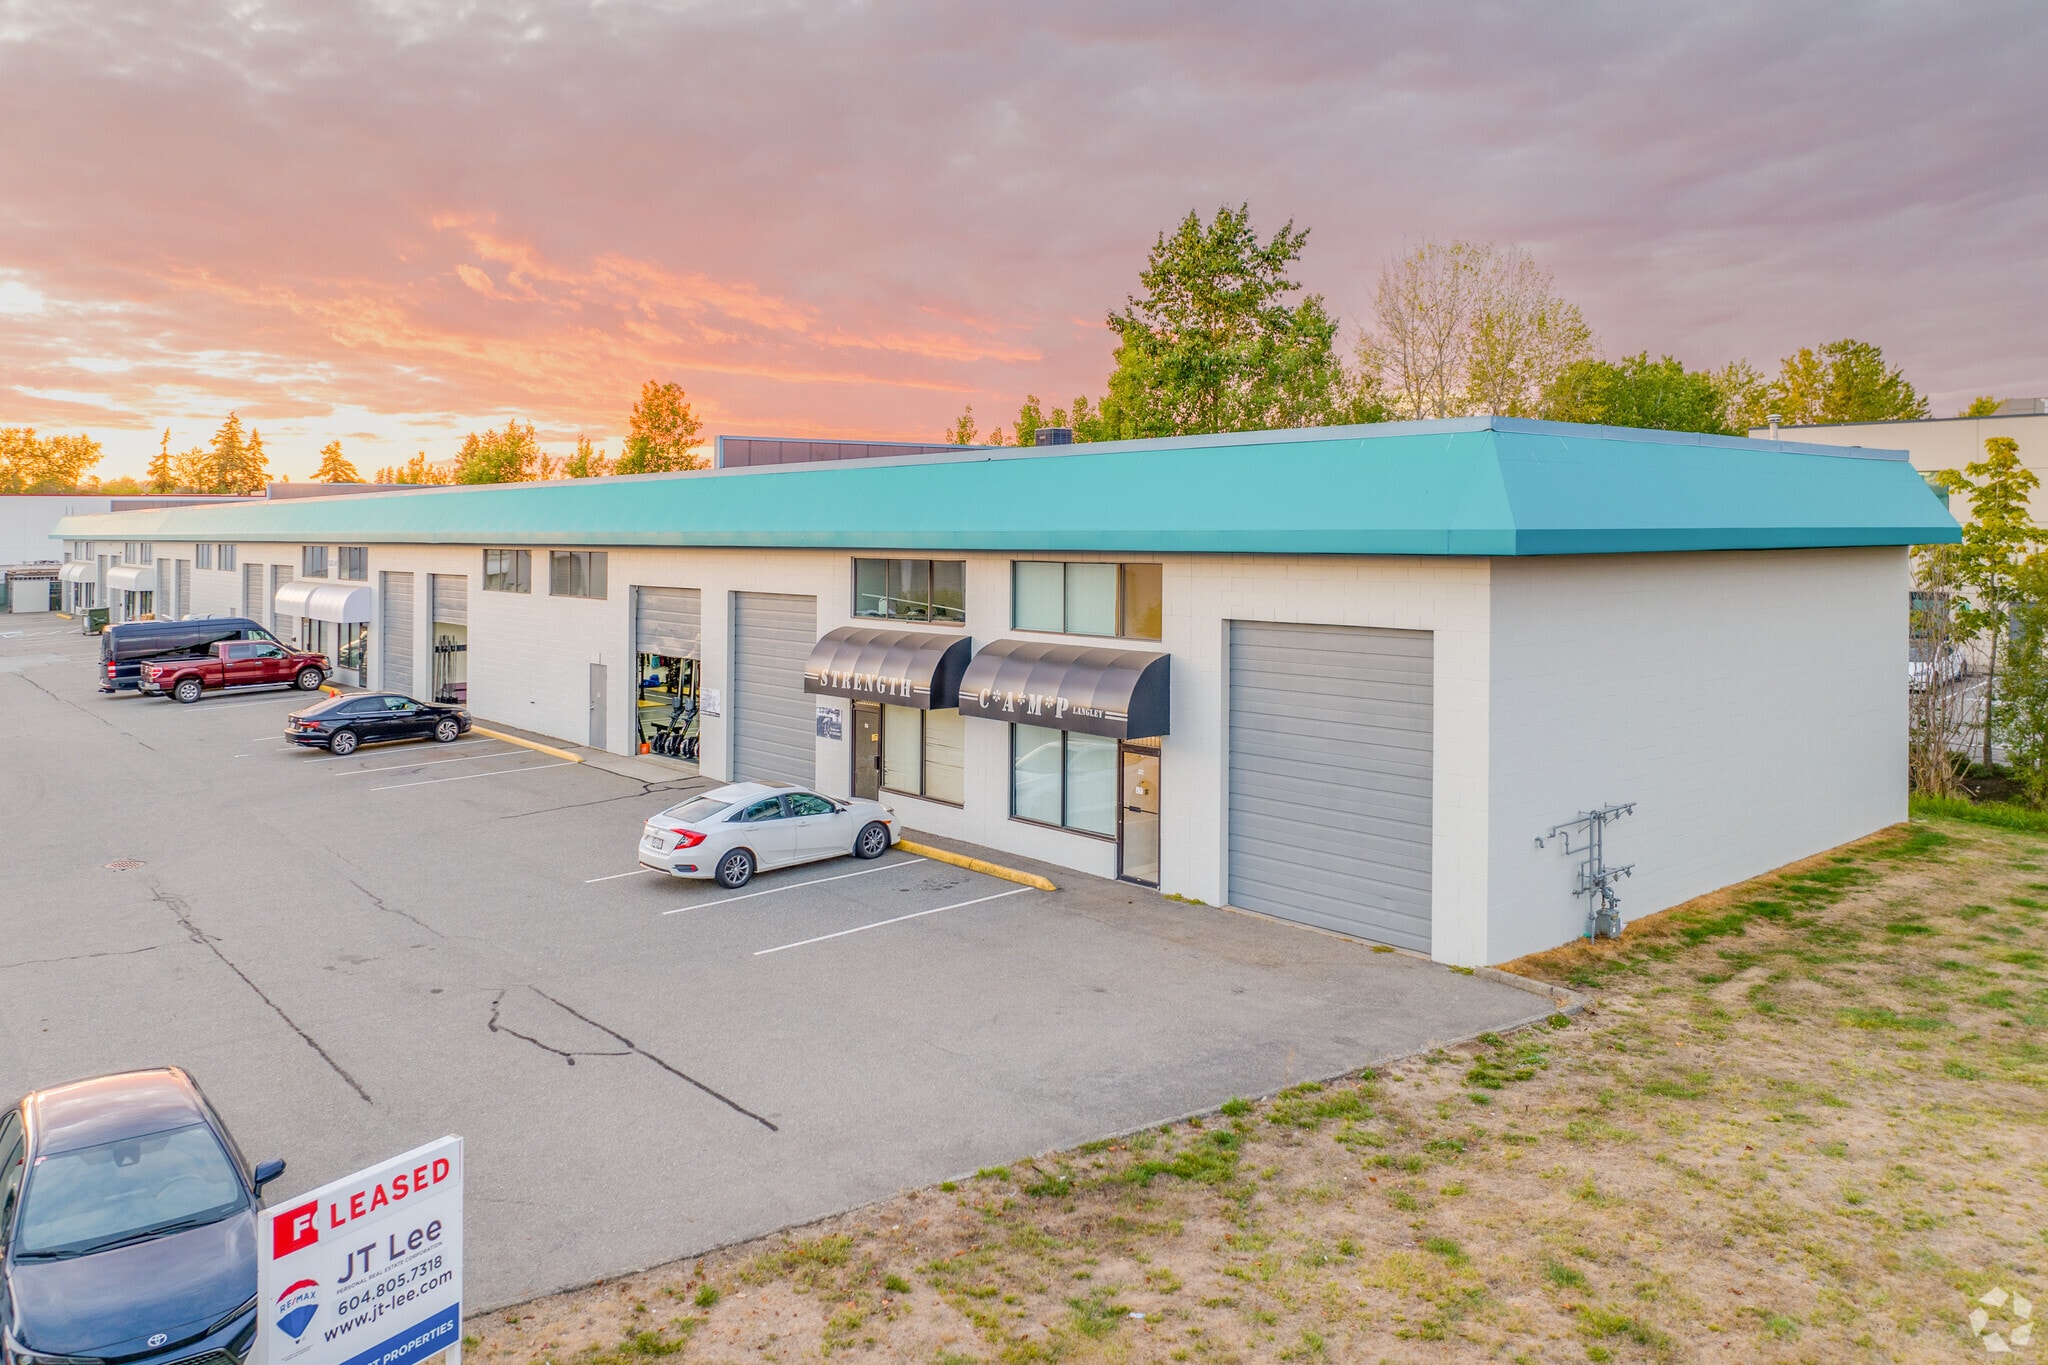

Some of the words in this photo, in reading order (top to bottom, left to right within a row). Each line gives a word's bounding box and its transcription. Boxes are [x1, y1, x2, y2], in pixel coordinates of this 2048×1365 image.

[820, 668, 912, 698] STRENGTH
[1072, 706, 1104, 719] LANGLEY
[330, 1157, 450, 1229] LEASED
[336, 1278, 367, 1295] PERSONAL
[368, 1270, 383, 1280] REAL
[384, 1259, 404, 1273] ESTATE
[404, 1241, 443, 1262] CORPORATION
[337, 1242, 377, 1284] JT
[389, 1219, 443, 1262] Lee
[279, 1290, 317, 1314] RE/MAX
[324, 1270, 453, 1343] www.jt-lee.com
[338, 1255, 443, 1316] 604.805.7318
[383, 1319, 454, 1365] PROPERTIES
